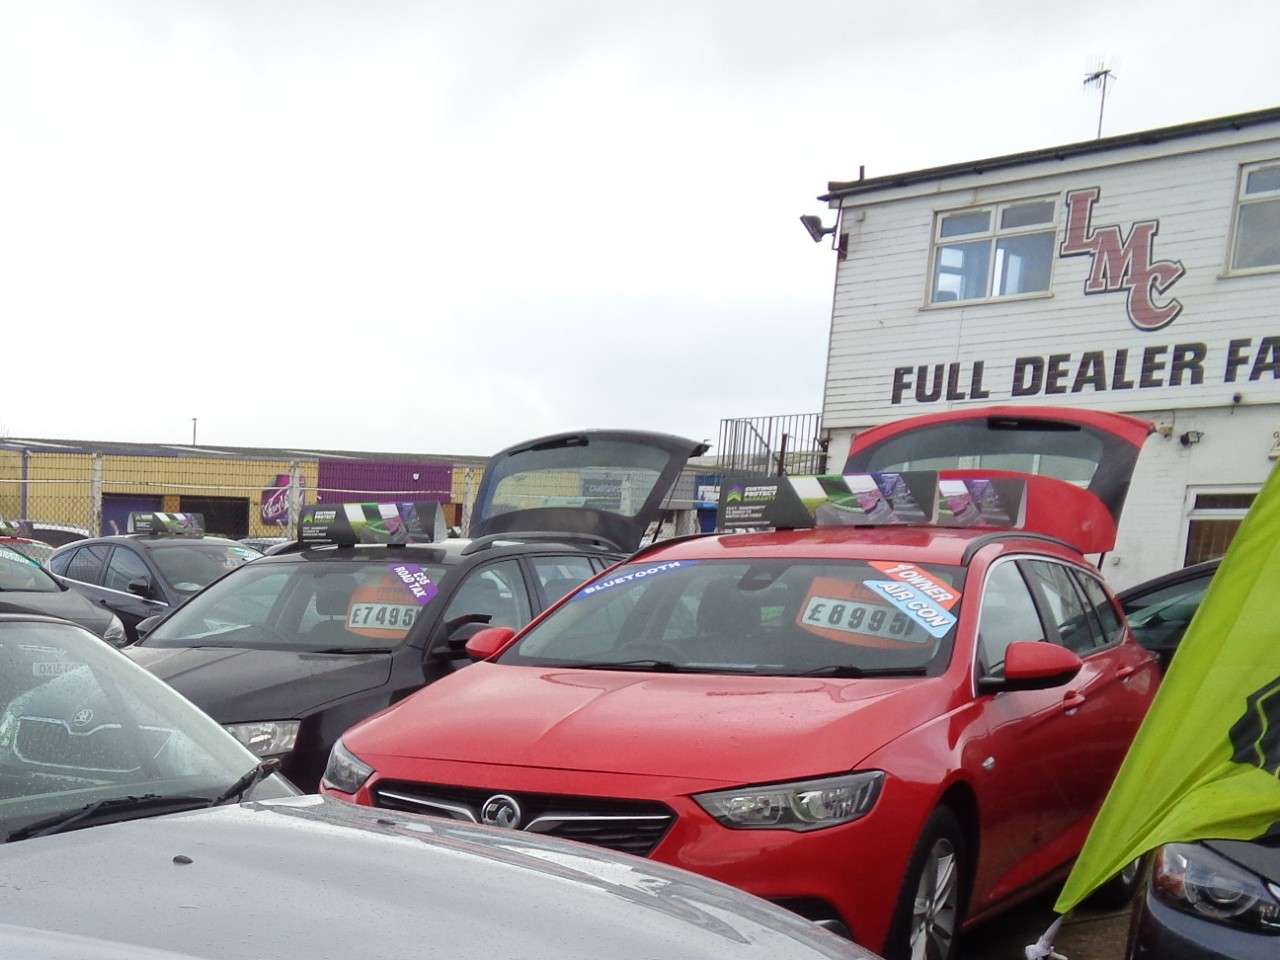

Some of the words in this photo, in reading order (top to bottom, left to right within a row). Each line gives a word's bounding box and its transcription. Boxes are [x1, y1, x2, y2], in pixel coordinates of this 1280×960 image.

[1059, 186, 1187, 332] LMC
[891, 361, 990, 405] FULL
[1011, 342, 1207, 397] DEALER
[393, 566, 415, 584] ROAD
[408, 582, 427, 598] TAX
[584, 561, 681, 594] BLUETOOTH
[898, 569, 954, 602] OWNER
[351, 606, 414, 627] £7495
[877, 582, 915, 602] AIR
[907, 599, 952, 628] CON
